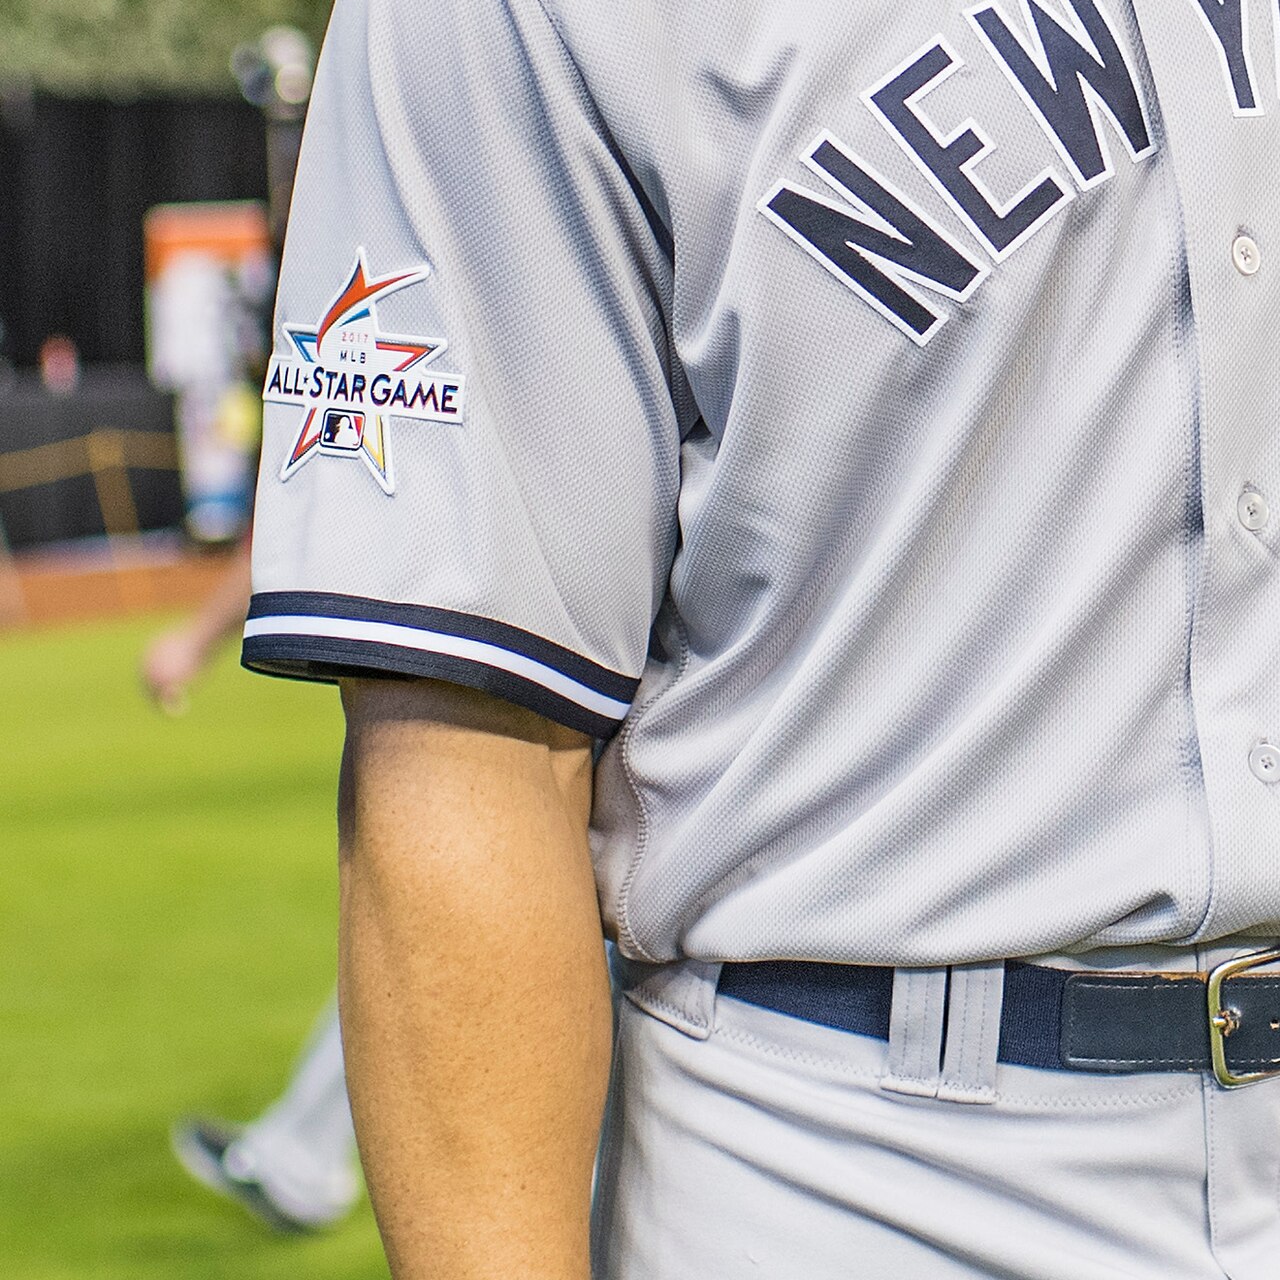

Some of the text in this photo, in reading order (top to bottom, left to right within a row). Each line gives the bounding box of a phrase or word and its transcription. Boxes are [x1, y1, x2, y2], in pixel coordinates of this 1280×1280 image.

[340, 331, 370, 343] 2017
[339, 352, 367, 365] MLB
[370, 373, 459, 415] GAME
